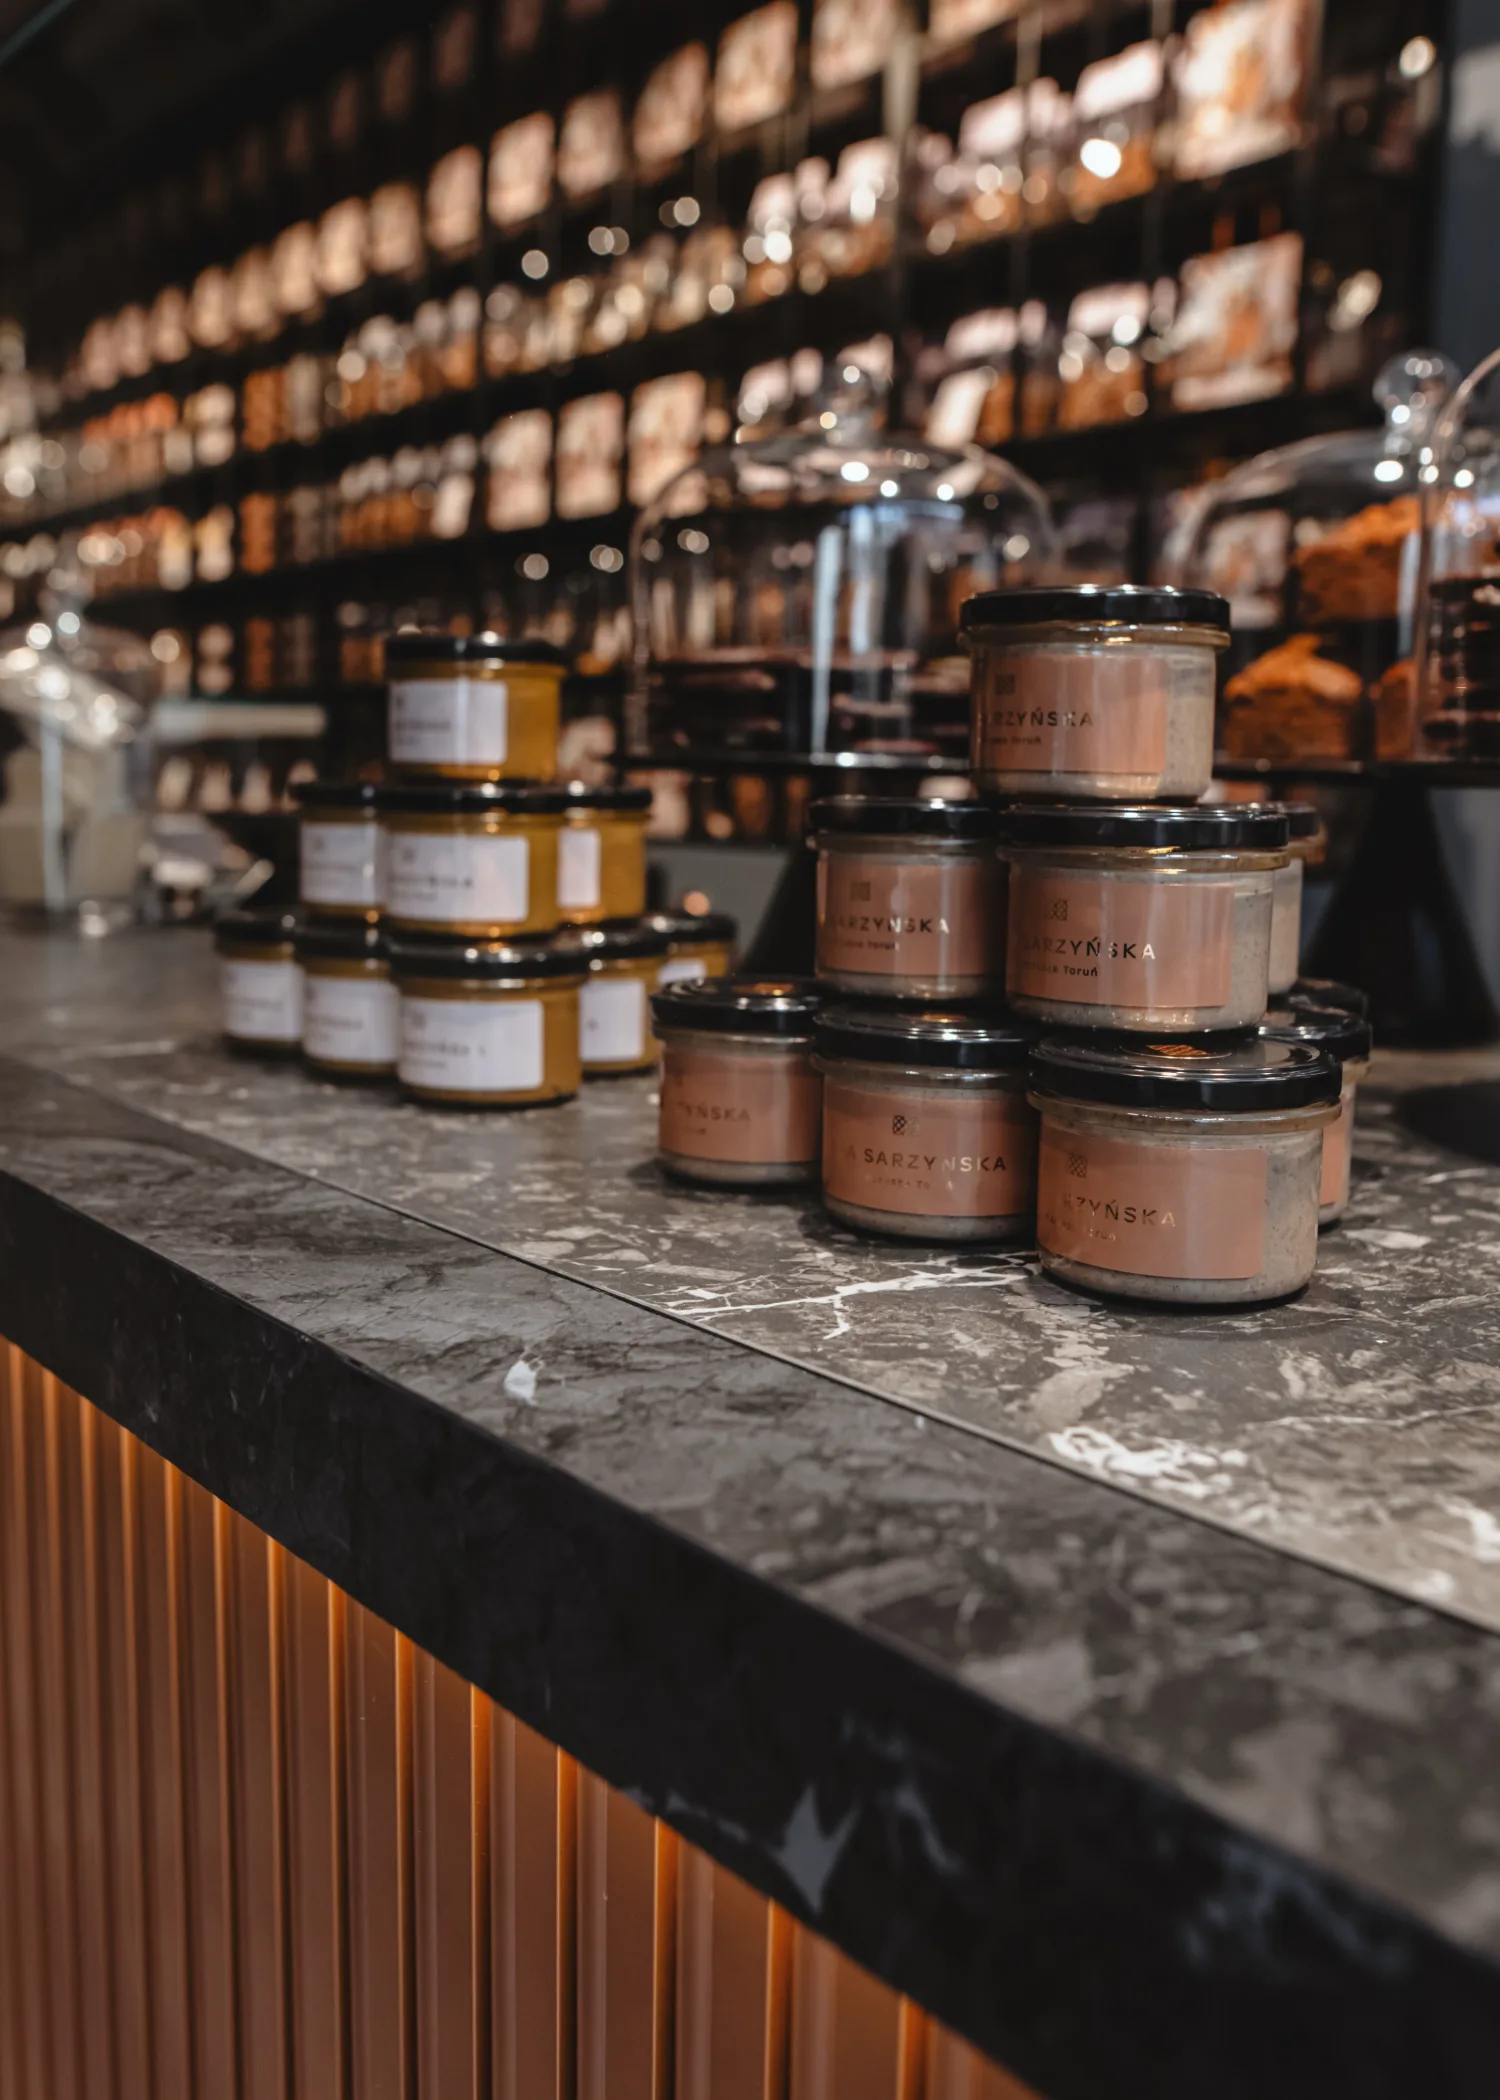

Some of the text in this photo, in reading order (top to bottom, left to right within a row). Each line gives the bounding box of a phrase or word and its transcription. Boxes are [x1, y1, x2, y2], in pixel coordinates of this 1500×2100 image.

[993, 706, 1093, 727] RZYŃSKA
[1063, 965, 1098, 977] Toruń
[1062, 1193, 1177, 1228] RZYŃSKA
